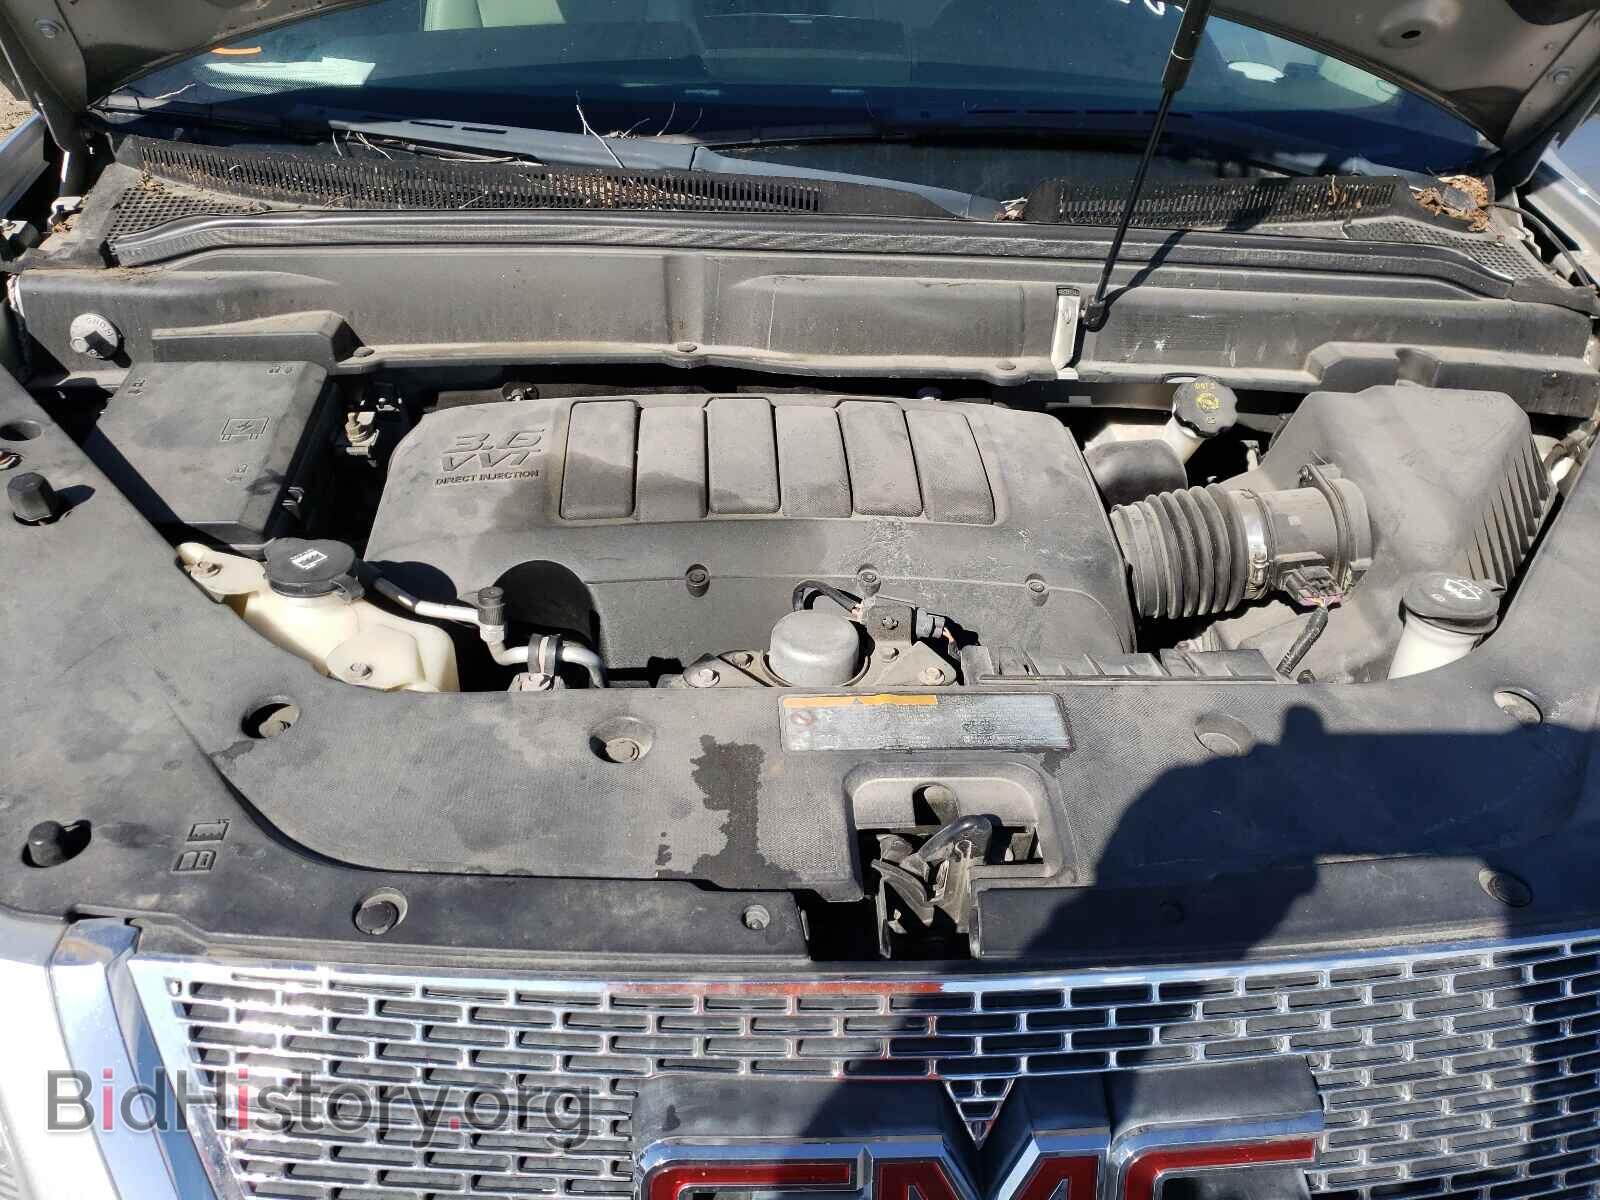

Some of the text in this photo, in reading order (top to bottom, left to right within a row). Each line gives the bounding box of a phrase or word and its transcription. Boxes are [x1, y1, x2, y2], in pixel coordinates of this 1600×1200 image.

[442, 428, 545, 454] 3.6
[441, 449, 542, 472] VVT
[434, 470, 540, 486] DIRECT INJECTION
